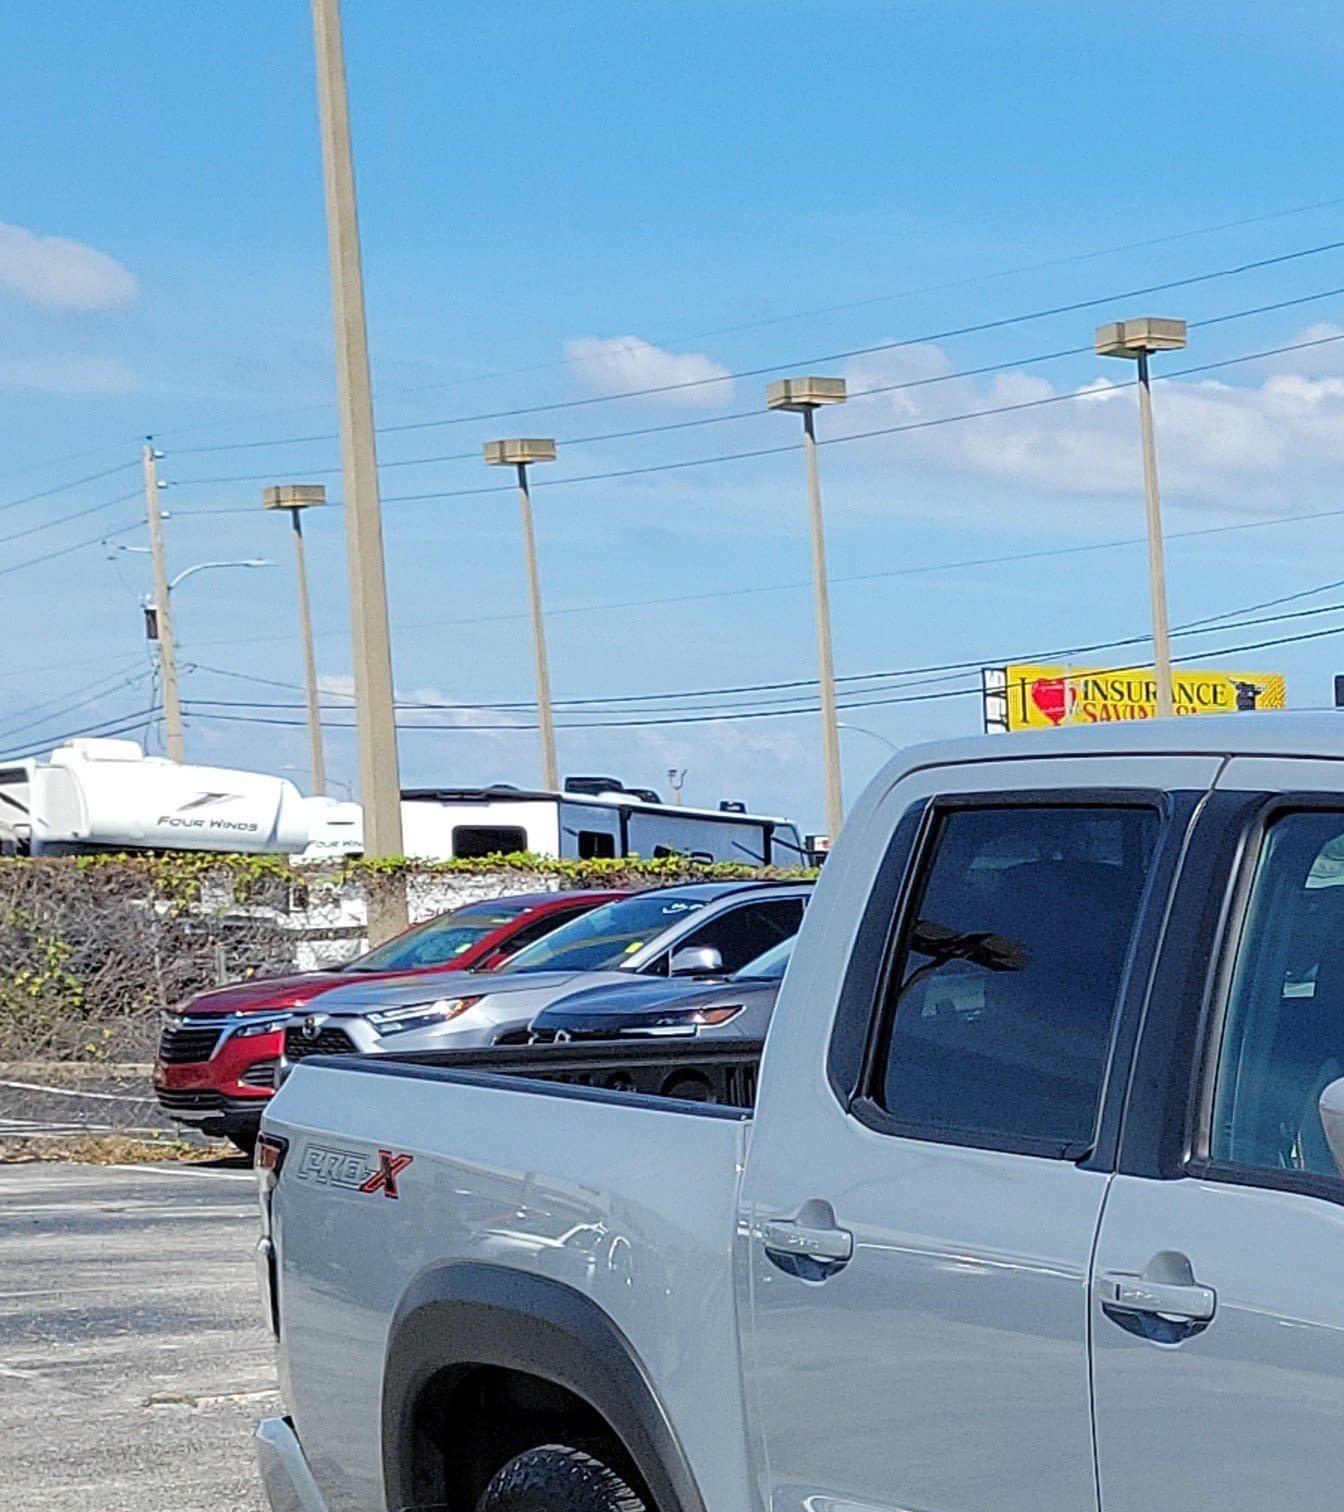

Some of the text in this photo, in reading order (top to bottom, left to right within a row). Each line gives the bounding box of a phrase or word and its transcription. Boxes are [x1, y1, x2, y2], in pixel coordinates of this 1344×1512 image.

[1018, 676, 1228, 724] I INSURNCE
[156, 815, 259, 832] FOUR WINDS
